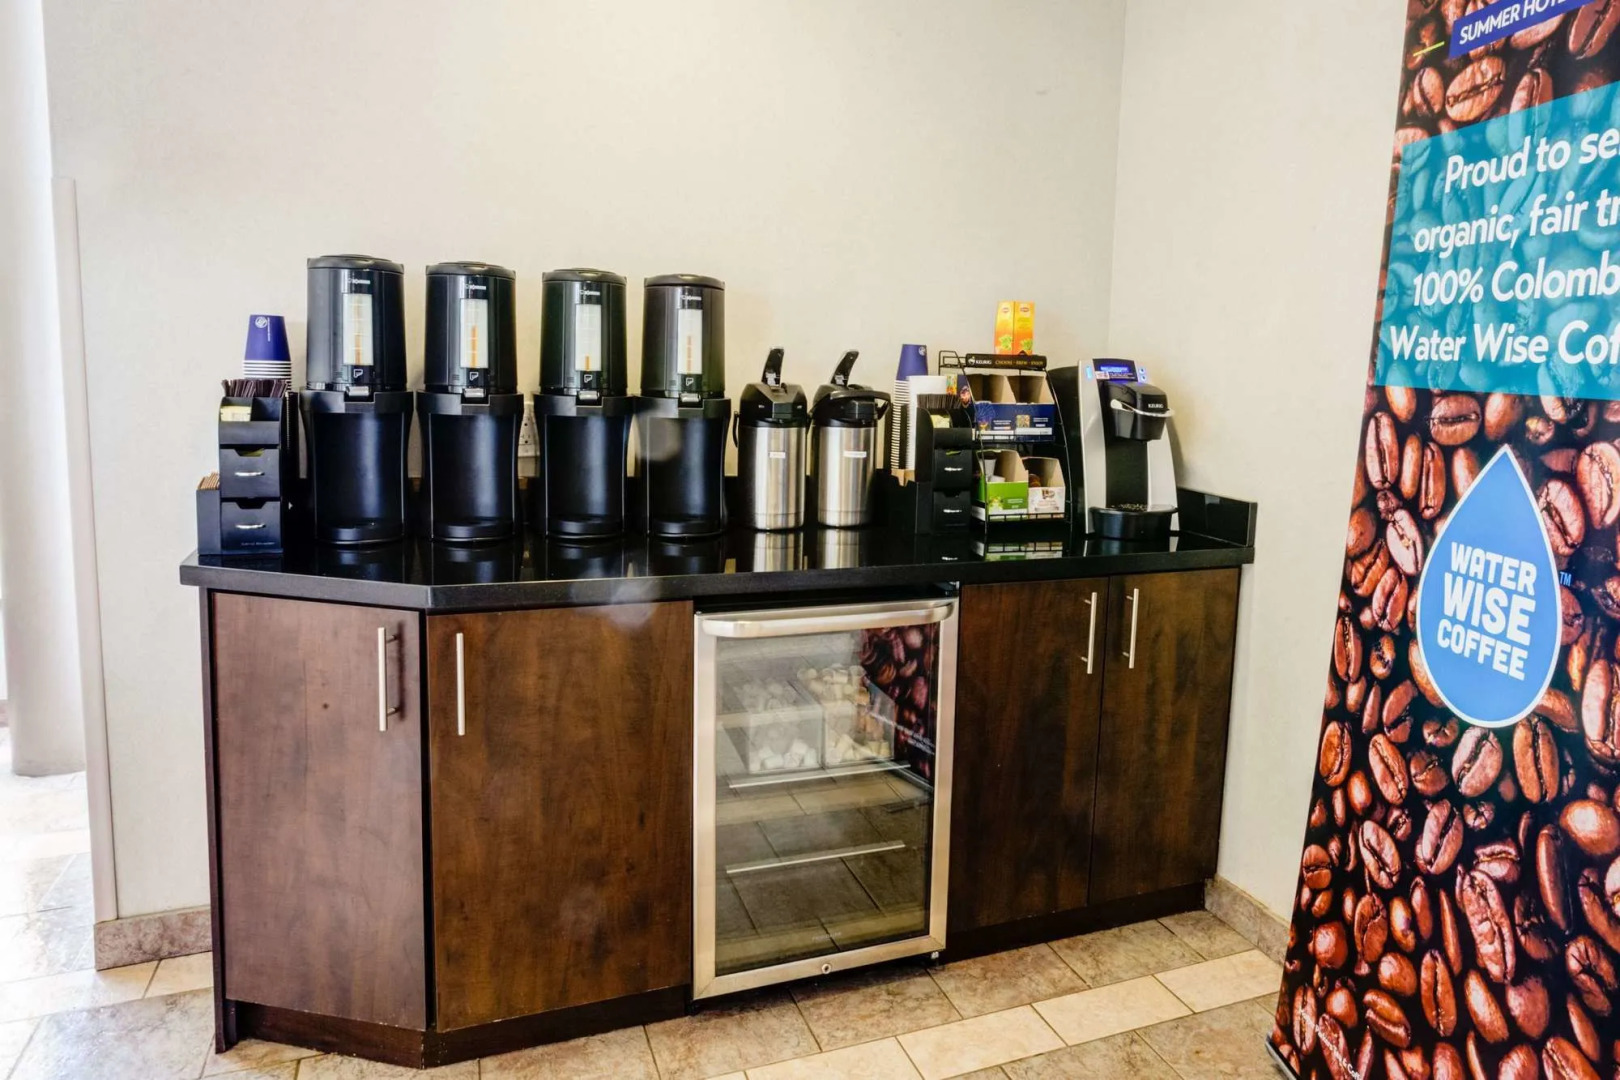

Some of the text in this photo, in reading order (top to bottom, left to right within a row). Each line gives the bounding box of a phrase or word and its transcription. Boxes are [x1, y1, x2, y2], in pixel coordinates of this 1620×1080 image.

[1459, 3, 1520, 45] SUMMER
[1445, 127, 1620, 193] Proud to se
[1414, 204, 1519, 259] organic,
[1529, 190, 1589, 237] fair
[1413, 250, 1620, 306] 100% Colomb
[1390, 325, 1466, 361] Water
[1473, 322, 1549, 363] Wise
[1451, 541, 1537, 596] WATER
[1559, 571, 1572, 587] TM
[1443, 572, 1536, 646] WISE
[1437, 618, 1528, 681] COFFEE
